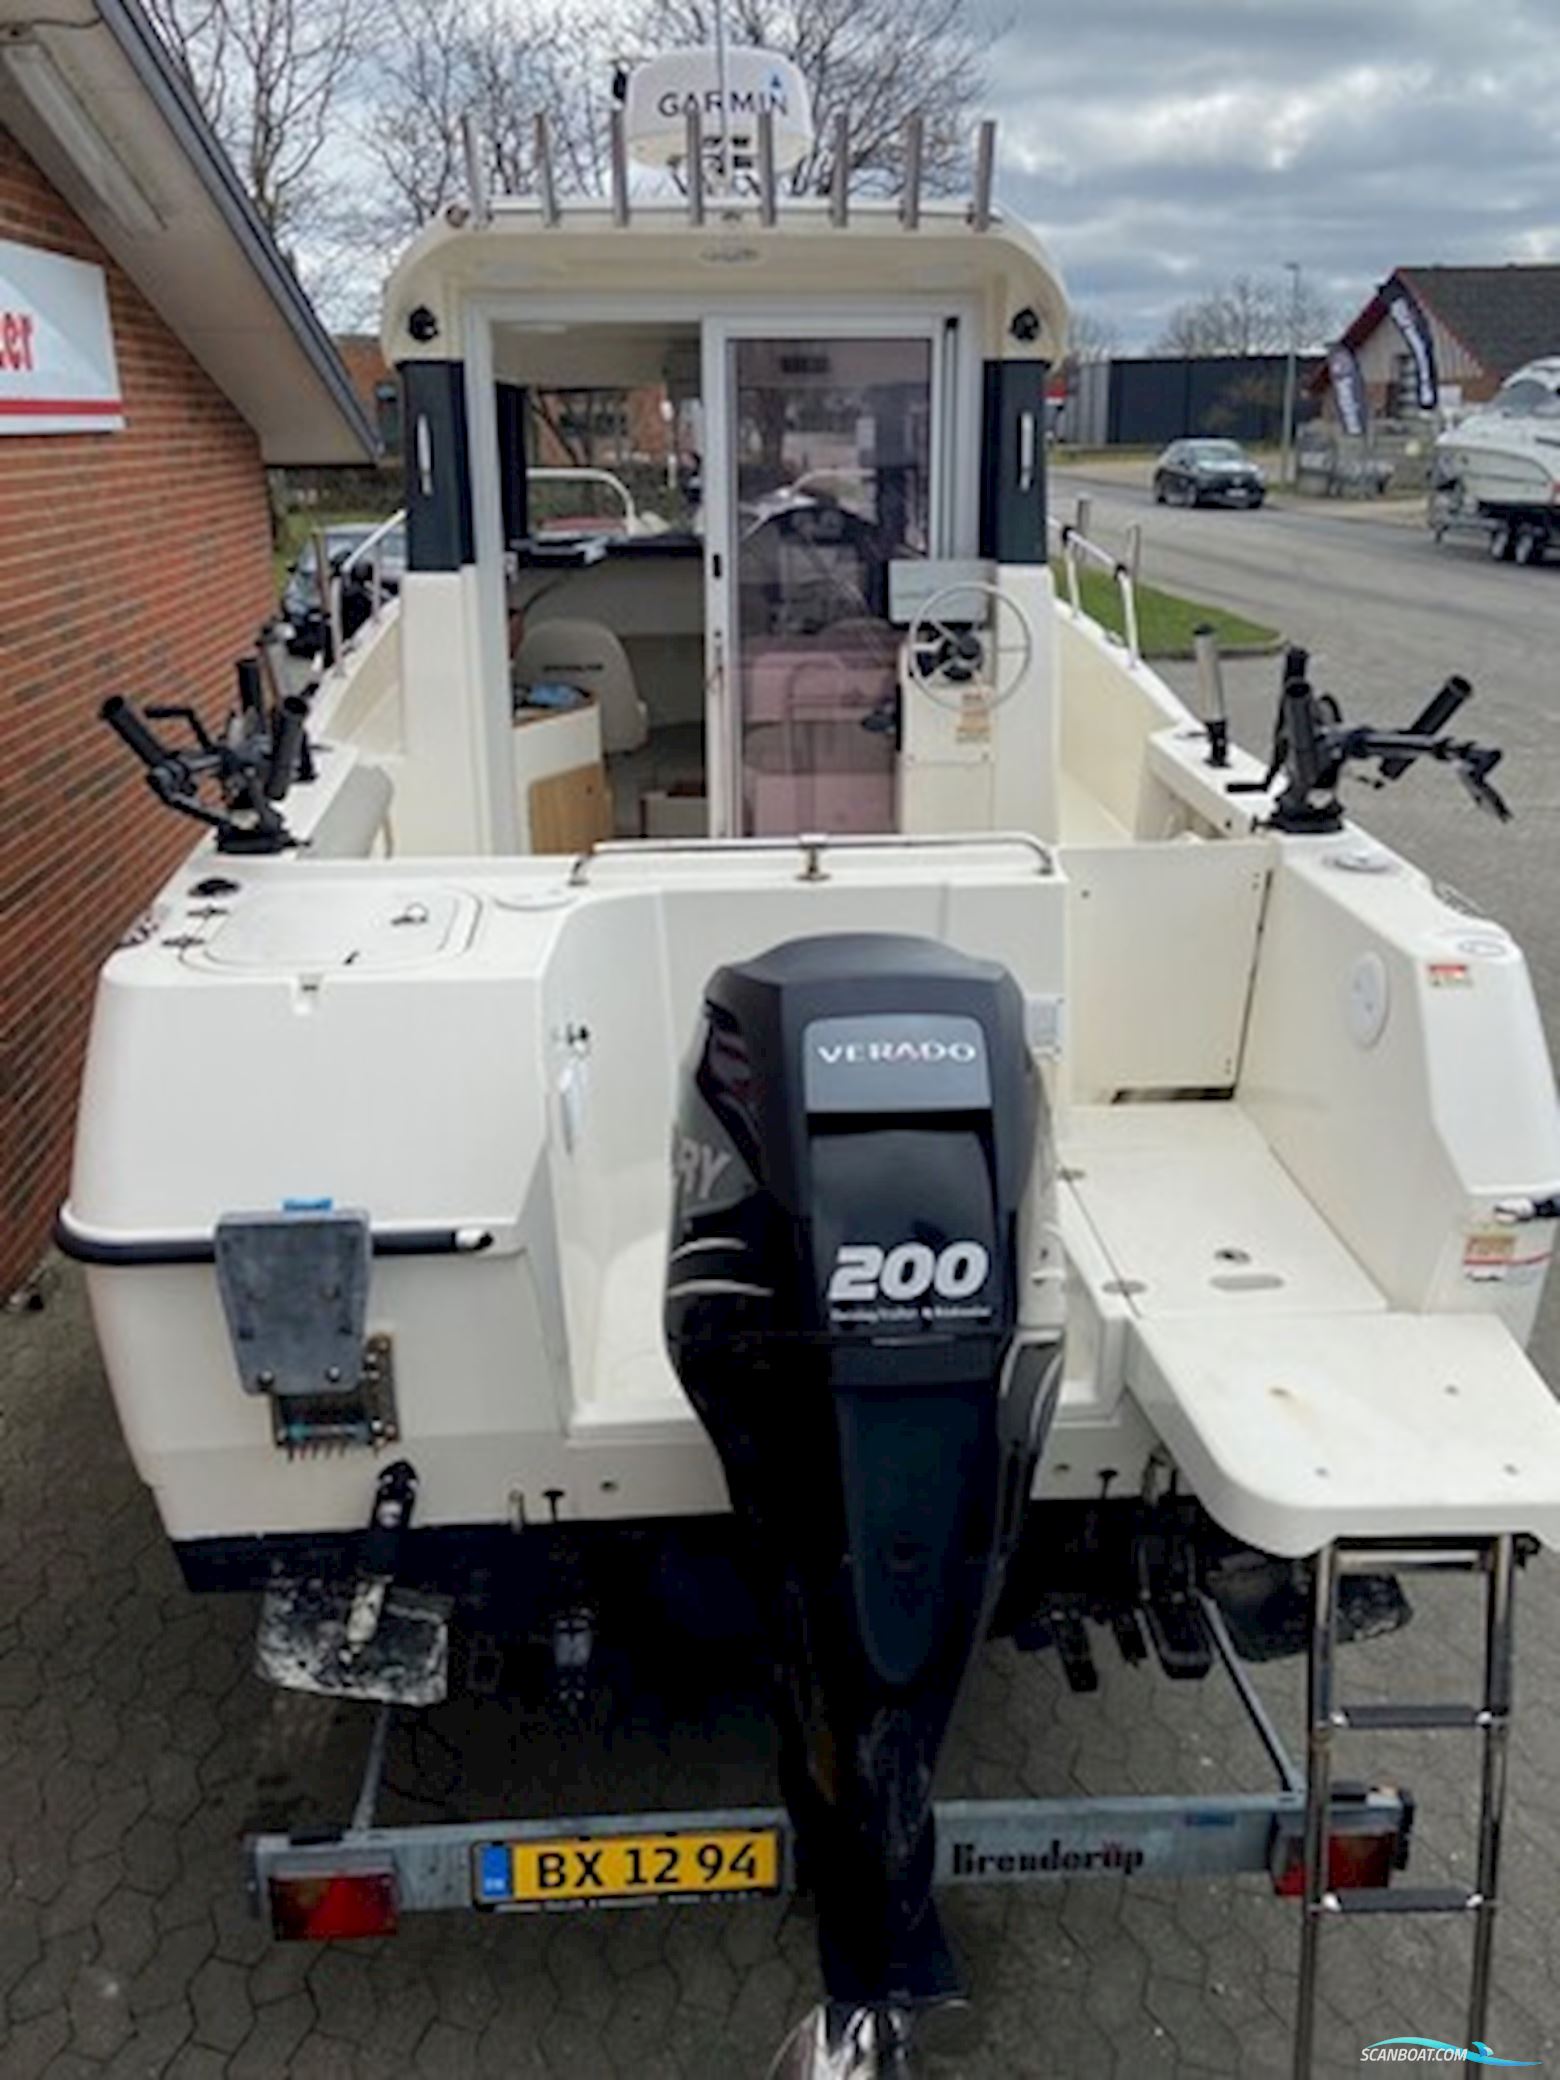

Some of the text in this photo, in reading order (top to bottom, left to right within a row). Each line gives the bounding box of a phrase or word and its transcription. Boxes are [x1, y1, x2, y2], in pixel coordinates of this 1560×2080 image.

[658, 91, 787, 118] GARMIN
[0, 312, 33, 371] er
[817, 1040, 977, 1065] VERADO
[828, 1240, 989, 1301] 200
[537, 1852, 603, 1890] BX
[624, 1847, 680, 1885] 12
[696, 1842, 756, 1883] 94
